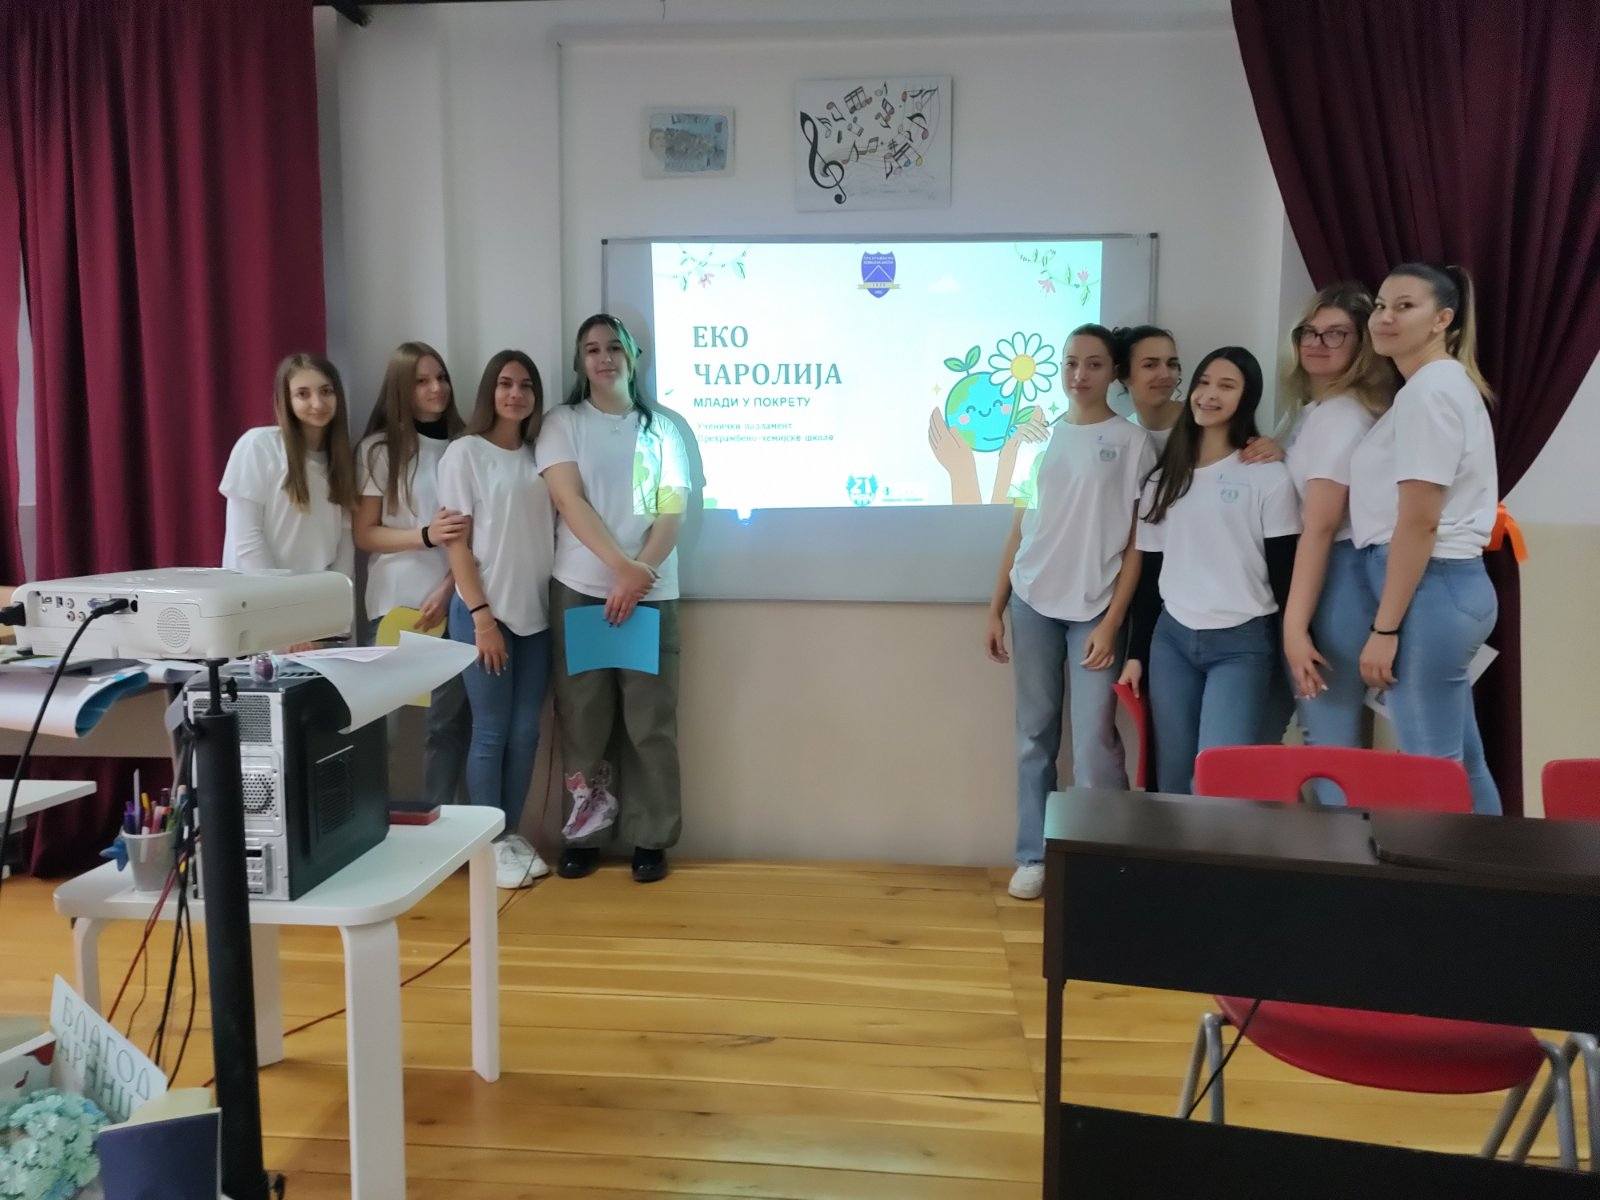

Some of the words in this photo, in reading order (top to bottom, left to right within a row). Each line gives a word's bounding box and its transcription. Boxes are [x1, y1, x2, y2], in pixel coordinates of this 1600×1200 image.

[693, 325, 749, 348] ЕКО
[694, 362, 843, 390] ЧАРОЛИЈА
[693, 397, 739, 408] МЛАДИ
[743, 397, 750, 408] У
[754, 396, 811, 408] ПОКРЕТУ
